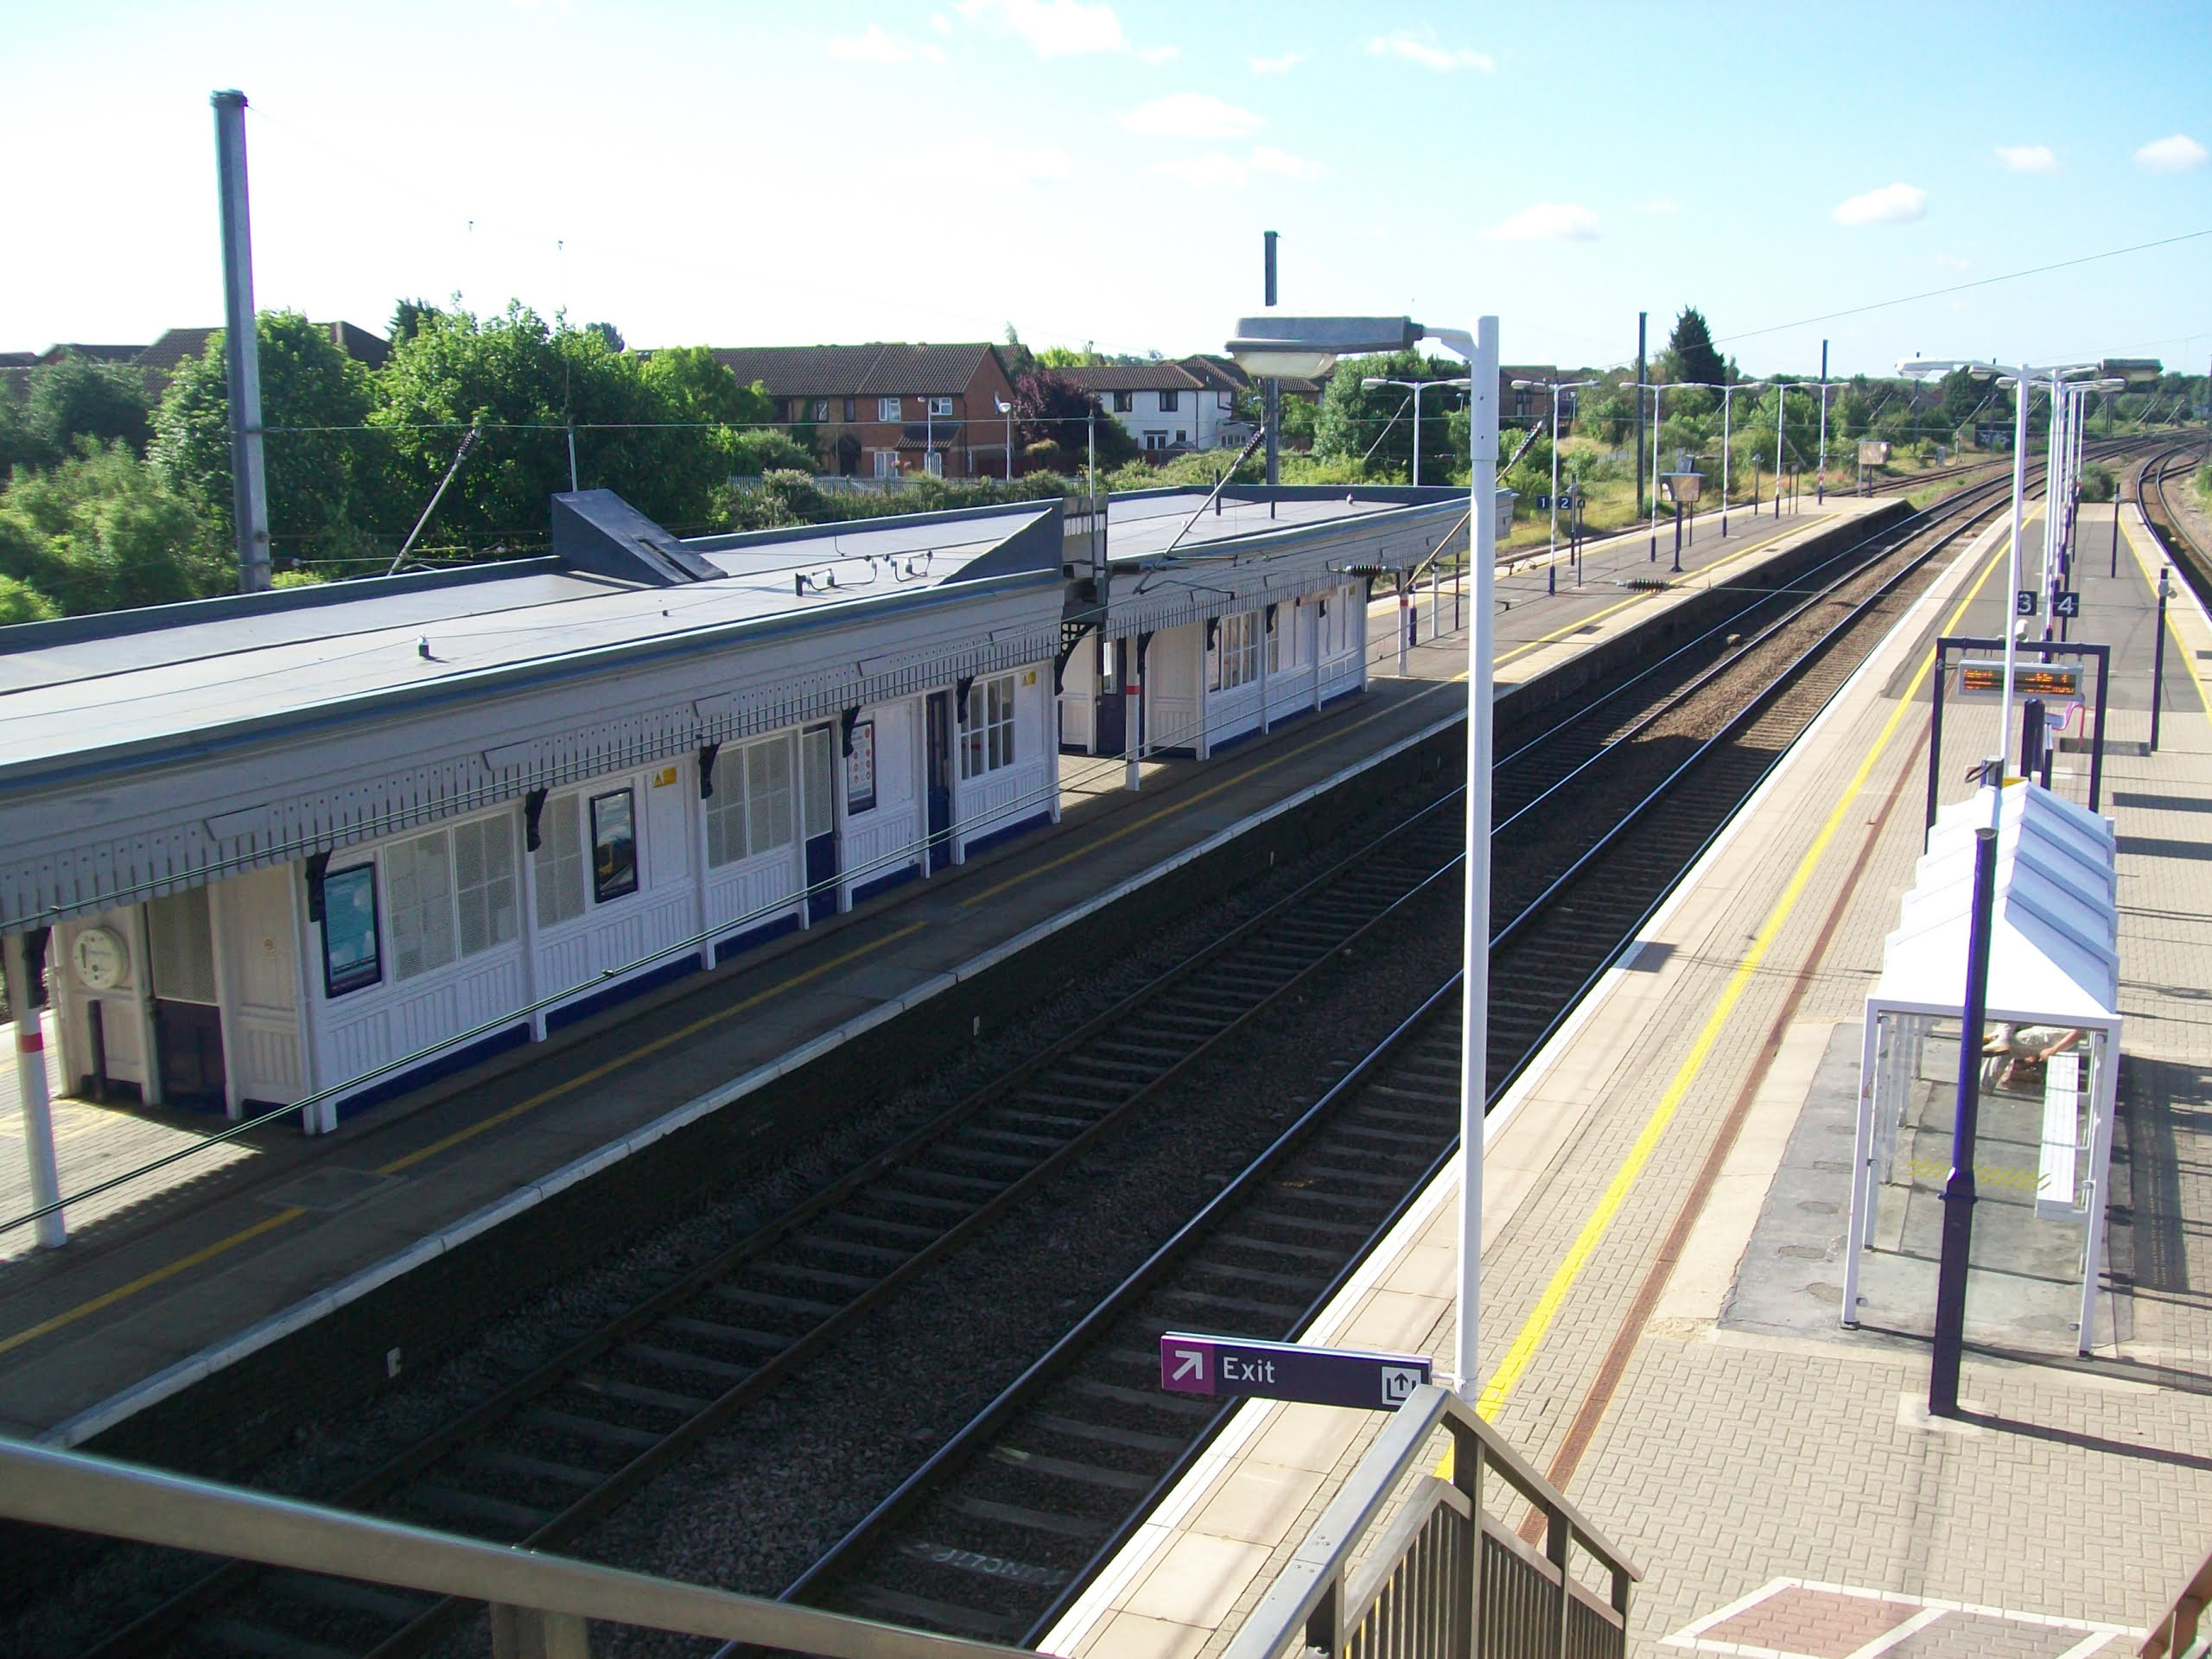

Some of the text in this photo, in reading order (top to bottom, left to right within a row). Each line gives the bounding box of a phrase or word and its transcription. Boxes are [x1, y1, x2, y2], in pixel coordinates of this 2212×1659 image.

[1541, 497, 1546, 508] 1
[1560, 498, 1569, 509] 2
[2018, 593, 2032, 613] 3
[2057, 595, 2074, 614] 4
[1223, 1357, 1275, 1383] Exit
